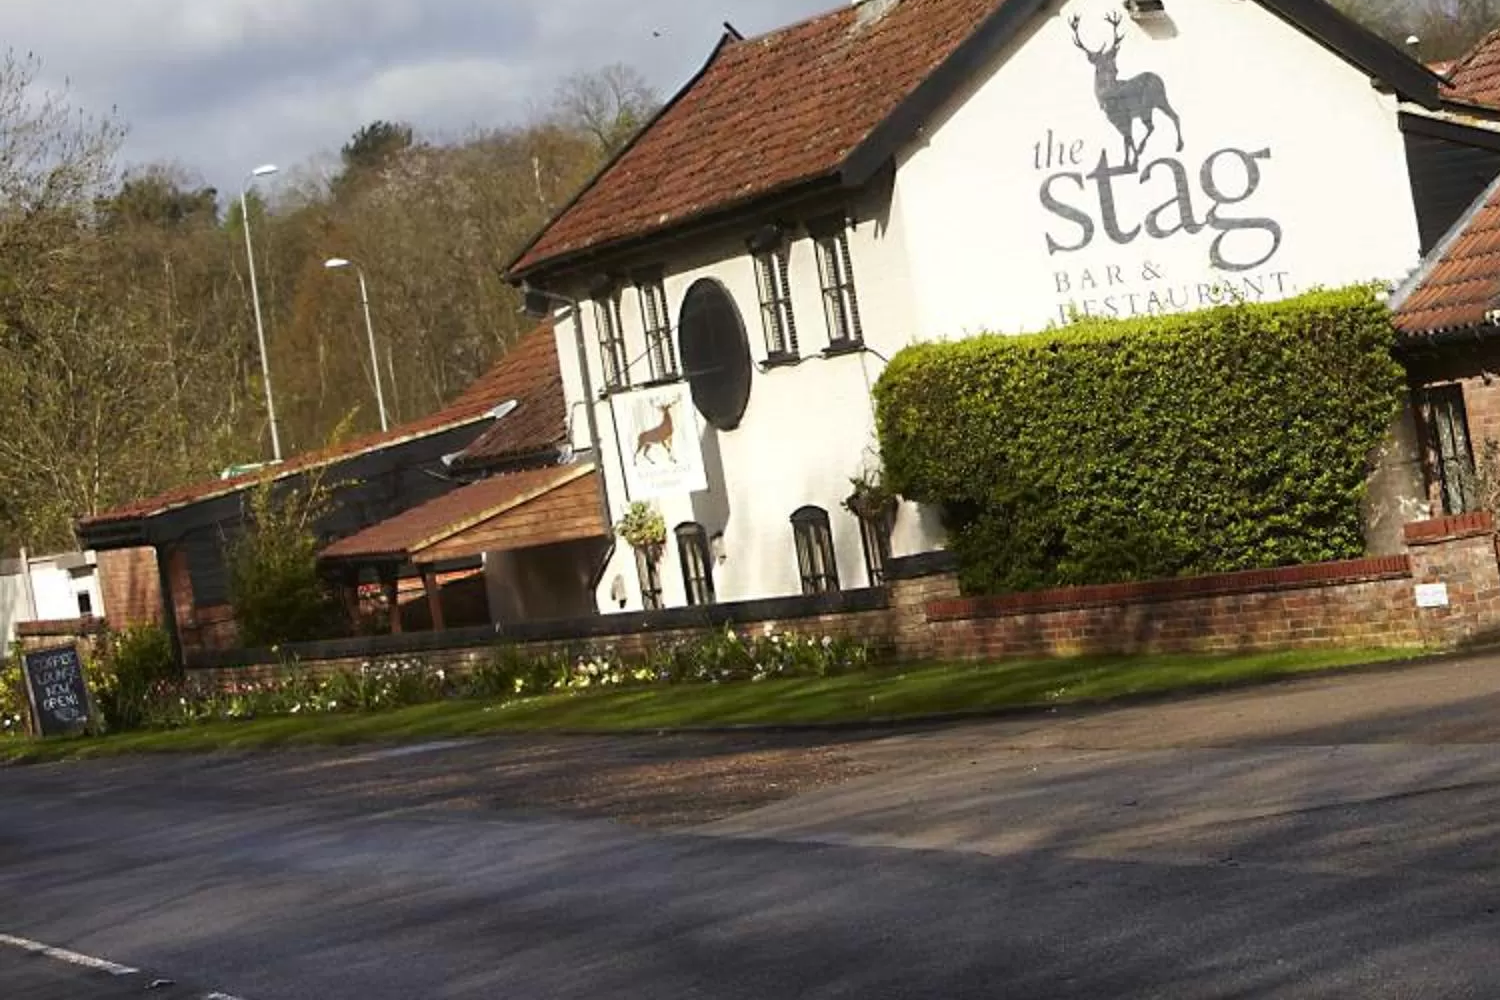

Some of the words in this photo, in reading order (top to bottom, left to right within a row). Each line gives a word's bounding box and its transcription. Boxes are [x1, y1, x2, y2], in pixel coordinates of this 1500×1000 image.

[1033, 128, 1085, 170] the
[1039, 147, 1283, 272] stag
[1054, 263, 1124, 293] BAR
[1141, 259, 1163, 281] &
